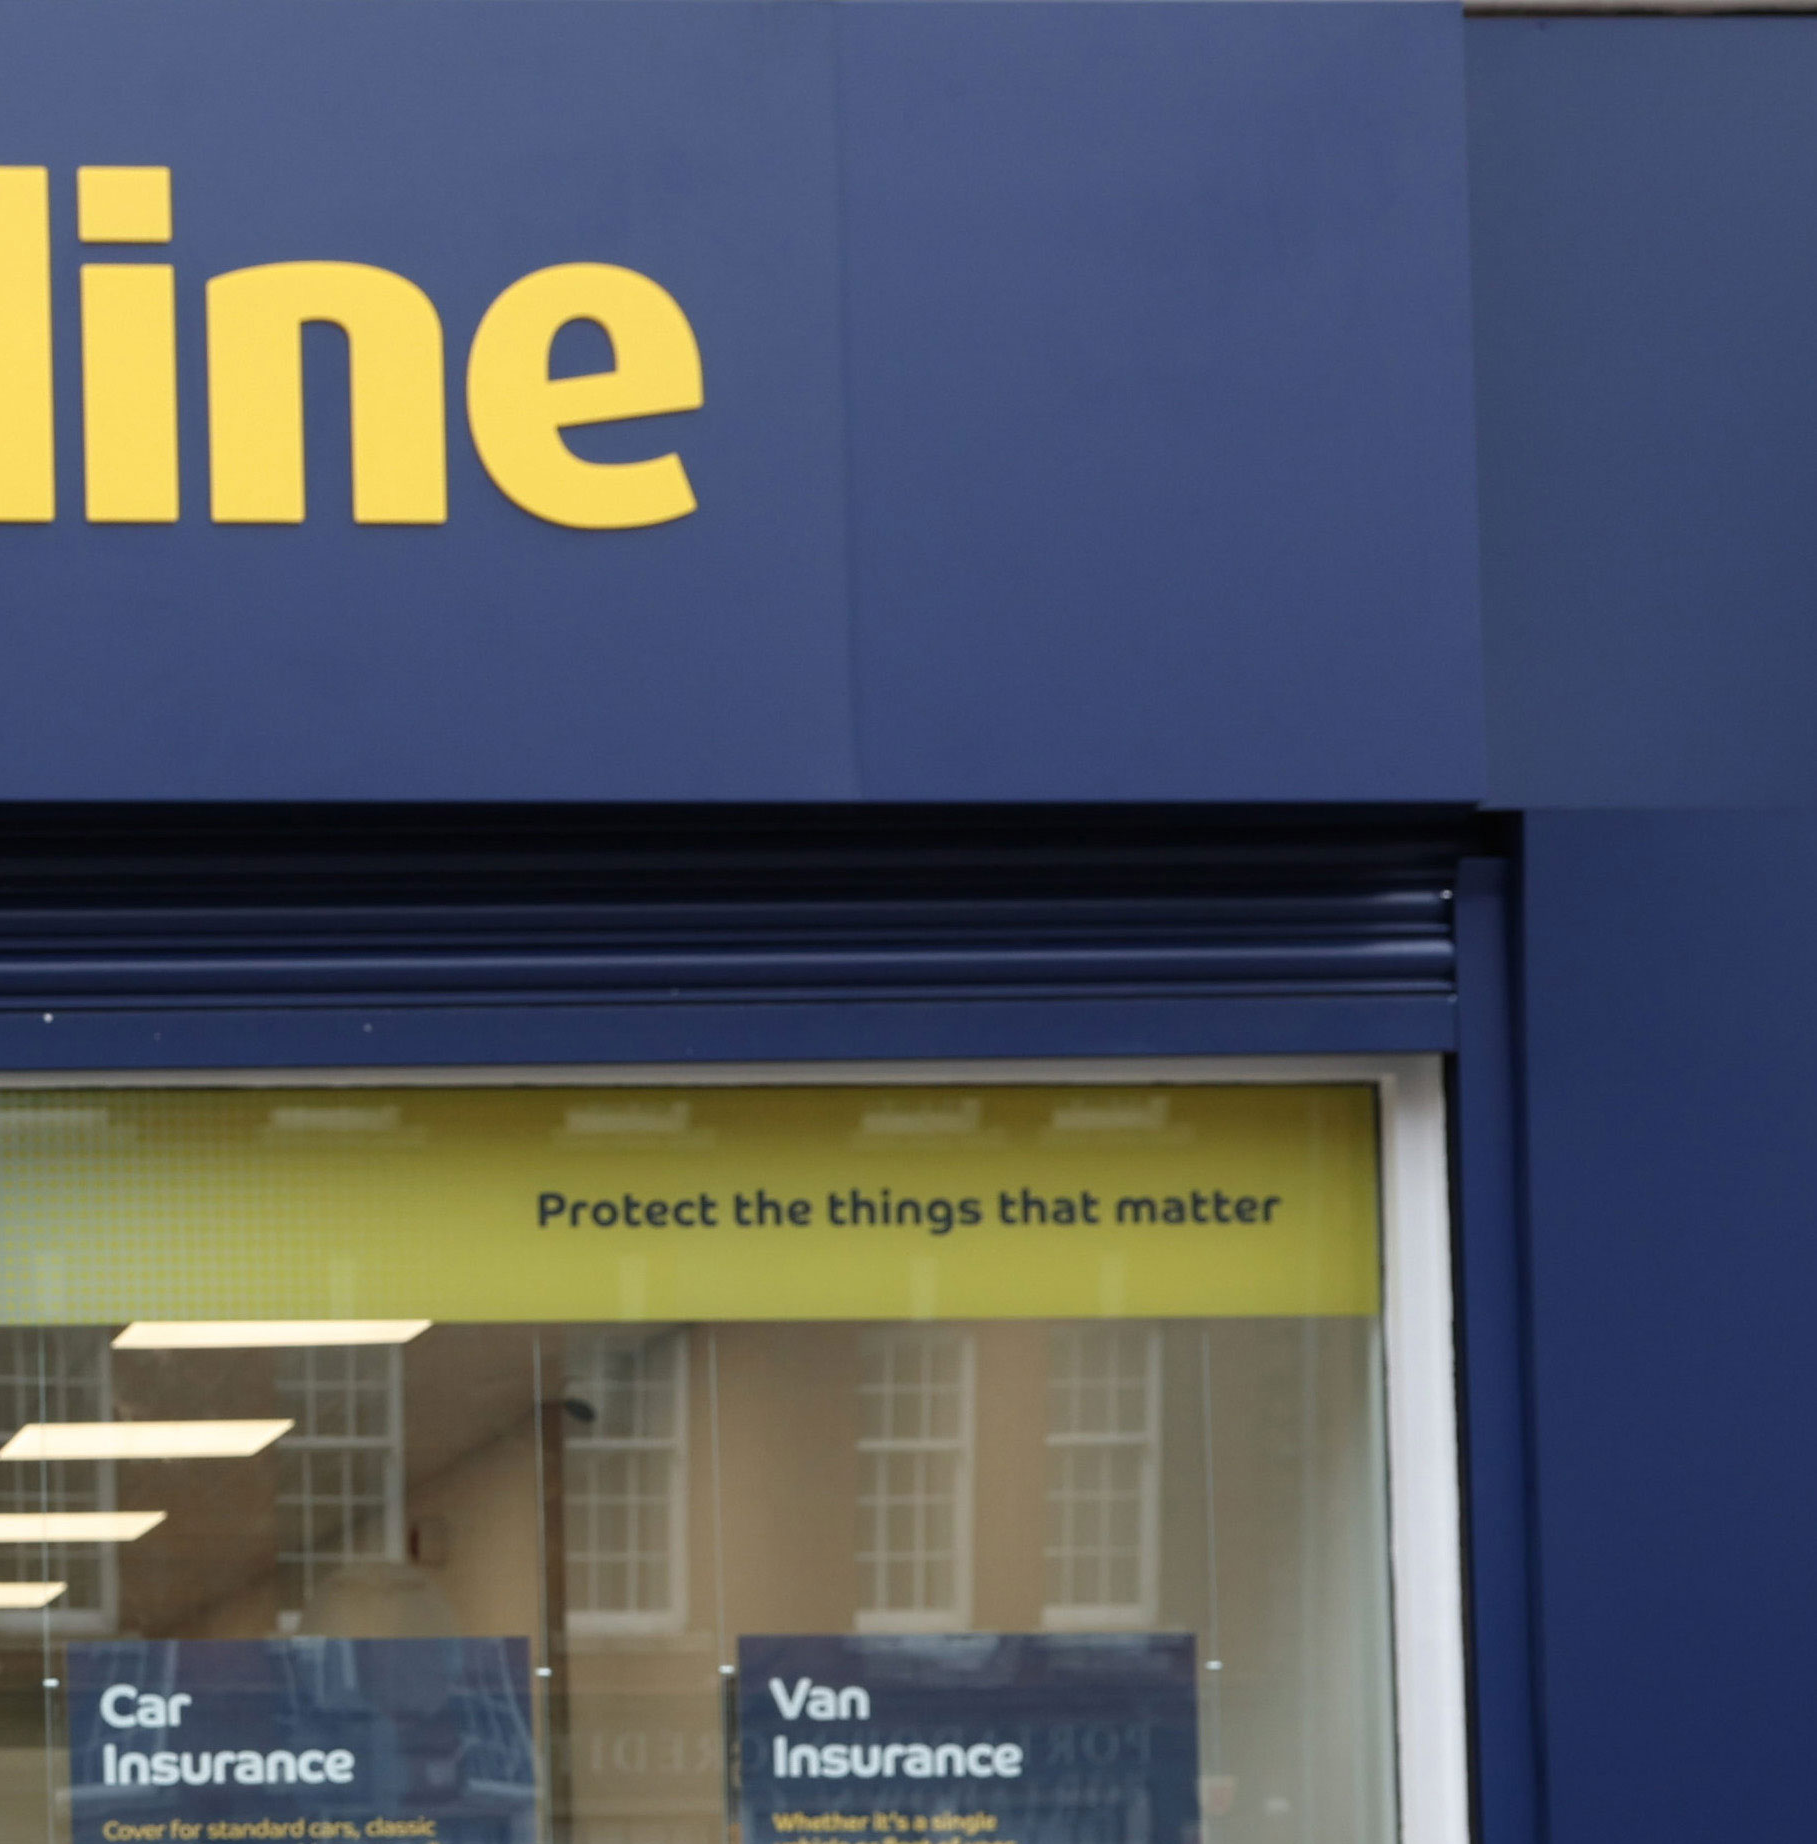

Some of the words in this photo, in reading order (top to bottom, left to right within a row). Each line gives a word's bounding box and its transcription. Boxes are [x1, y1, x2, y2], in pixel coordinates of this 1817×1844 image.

[537, 1189, 718, 1228] Protect
[733, 1188, 812, 1227] the
[827, 1187, 982, 1236] things
[997, 1187, 1099, 1226] that
[1116, 1187, 1282, 1226] matter
[100, 1683, 192, 1728] Car
[768, 1676, 871, 1720] Van
[102, 1743, 355, 1785] Insurance
[773, 1735, 1024, 1779] Insurance
[102, 1818, 166, 1842] Cover
[169, 1817, 202, 1840] for
[206, 1817, 305, 1840] standard
[308, 1819, 360, 1840] cars,
[364, 1816, 437, 1838] classic
[773, 1812, 868, 1832] Whether
[912, 1816, 928, 1832] a
[931, 1811, 997, 1836] single
